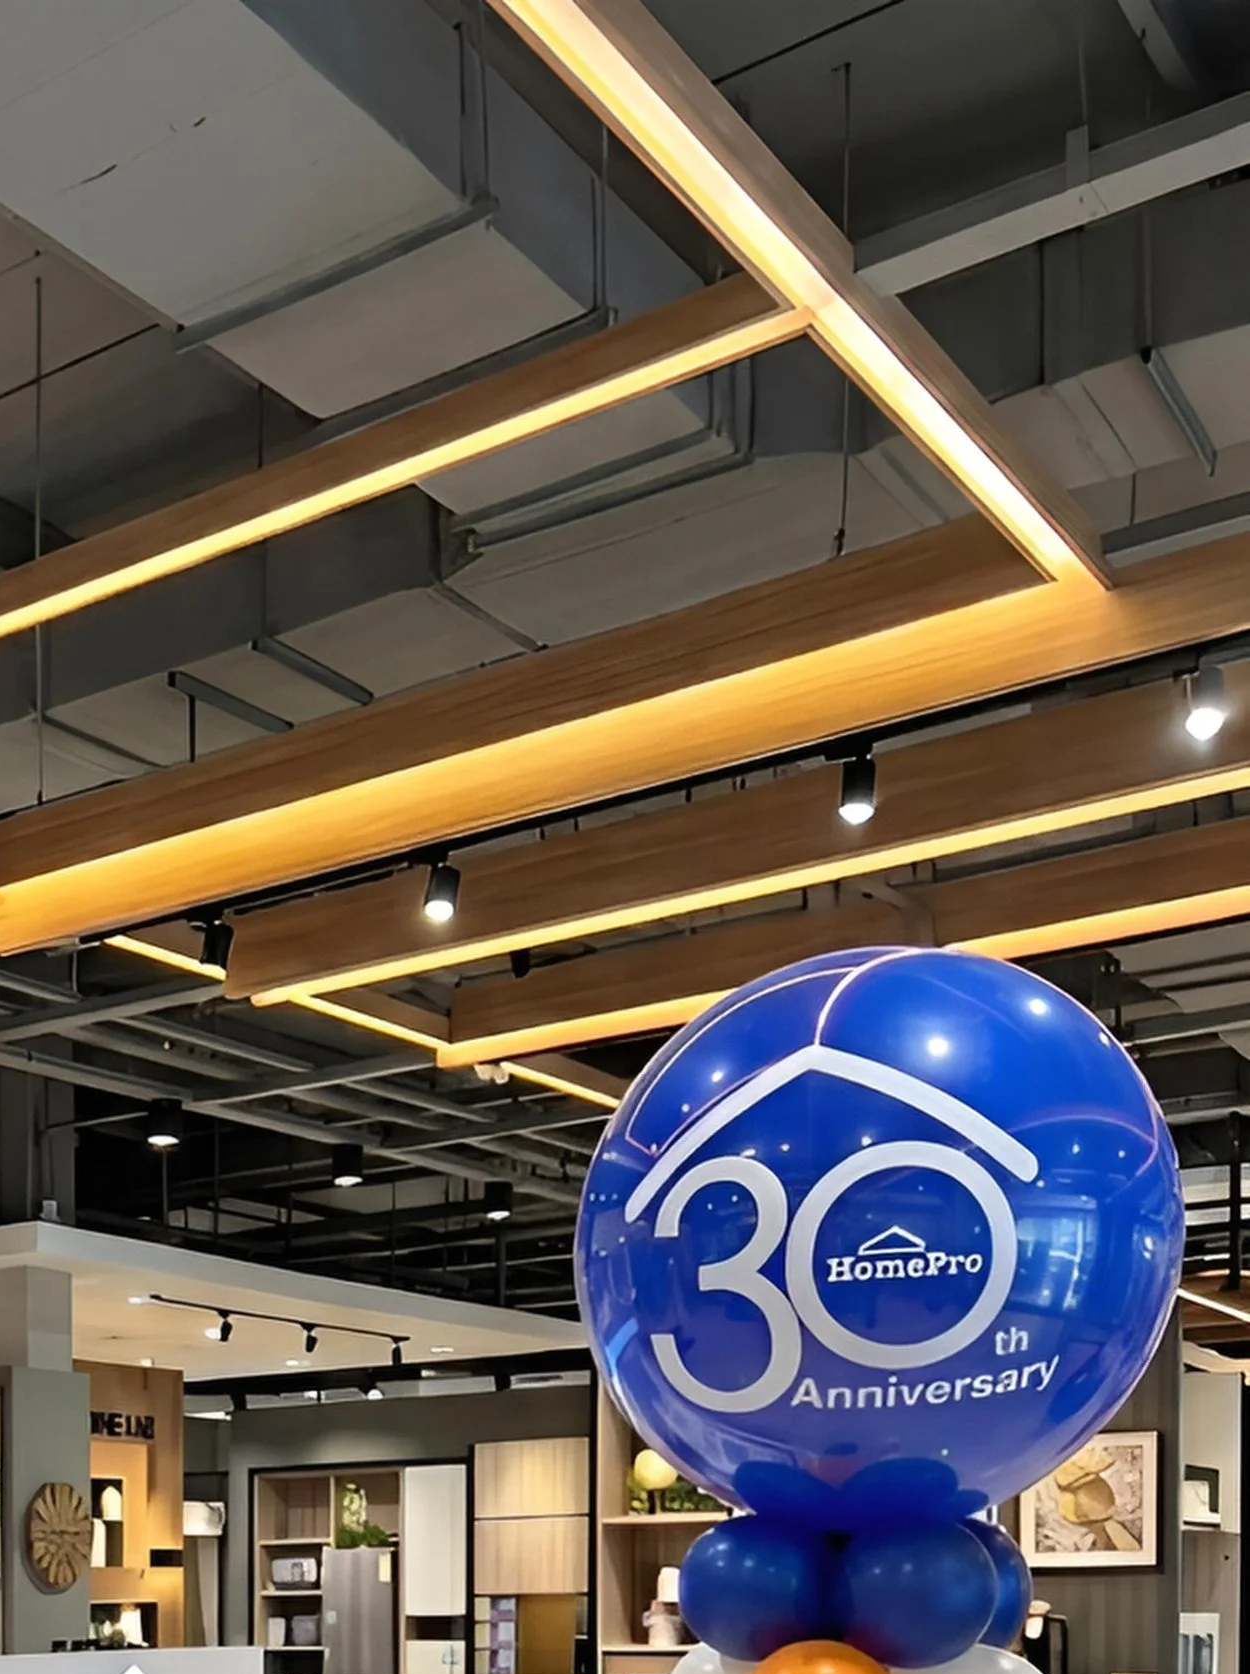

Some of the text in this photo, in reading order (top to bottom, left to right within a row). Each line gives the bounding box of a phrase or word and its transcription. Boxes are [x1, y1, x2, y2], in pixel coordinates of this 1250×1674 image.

[650, 1141, 1029, 1413] 30 th
[826, 1252, 983, 1283] HomePro
[790, 1354, 1060, 1409] Anniversary
